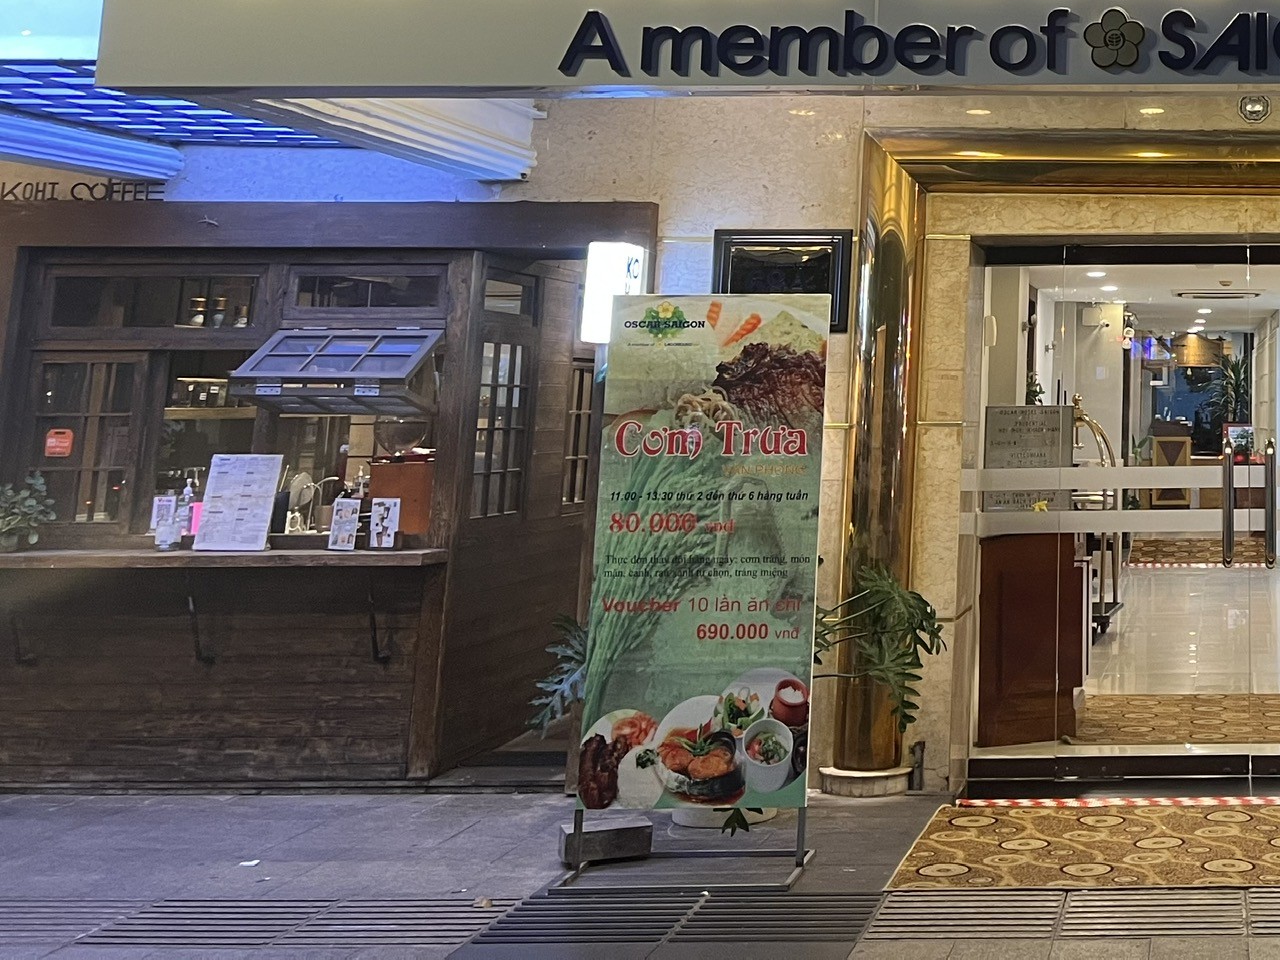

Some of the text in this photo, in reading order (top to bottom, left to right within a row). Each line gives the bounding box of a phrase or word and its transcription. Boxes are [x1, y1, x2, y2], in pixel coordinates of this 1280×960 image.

[558, 10, 629, 77] A
[641, 8, 975, 76] member
[988, 8, 1070, 72] of
[1, 181, 166, 201] KOHI COFFEE
[624, 320, 706, 329] OSCAR SAIGON
[614, 420, 808, 459] Cơm Trưa
[697, 491, 703, 501] 2
[748, 491, 755, 501] 6
[609, 511, 697, 533] 80.000
[740, 555, 760, 564] cơm
[790, 554, 810, 564] món
[602, 596, 681, 613] Voucher
[688, 596, 709, 612] 10
[747, 596, 769, 612] ăn
[696, 623, 769, 640] 690.000
